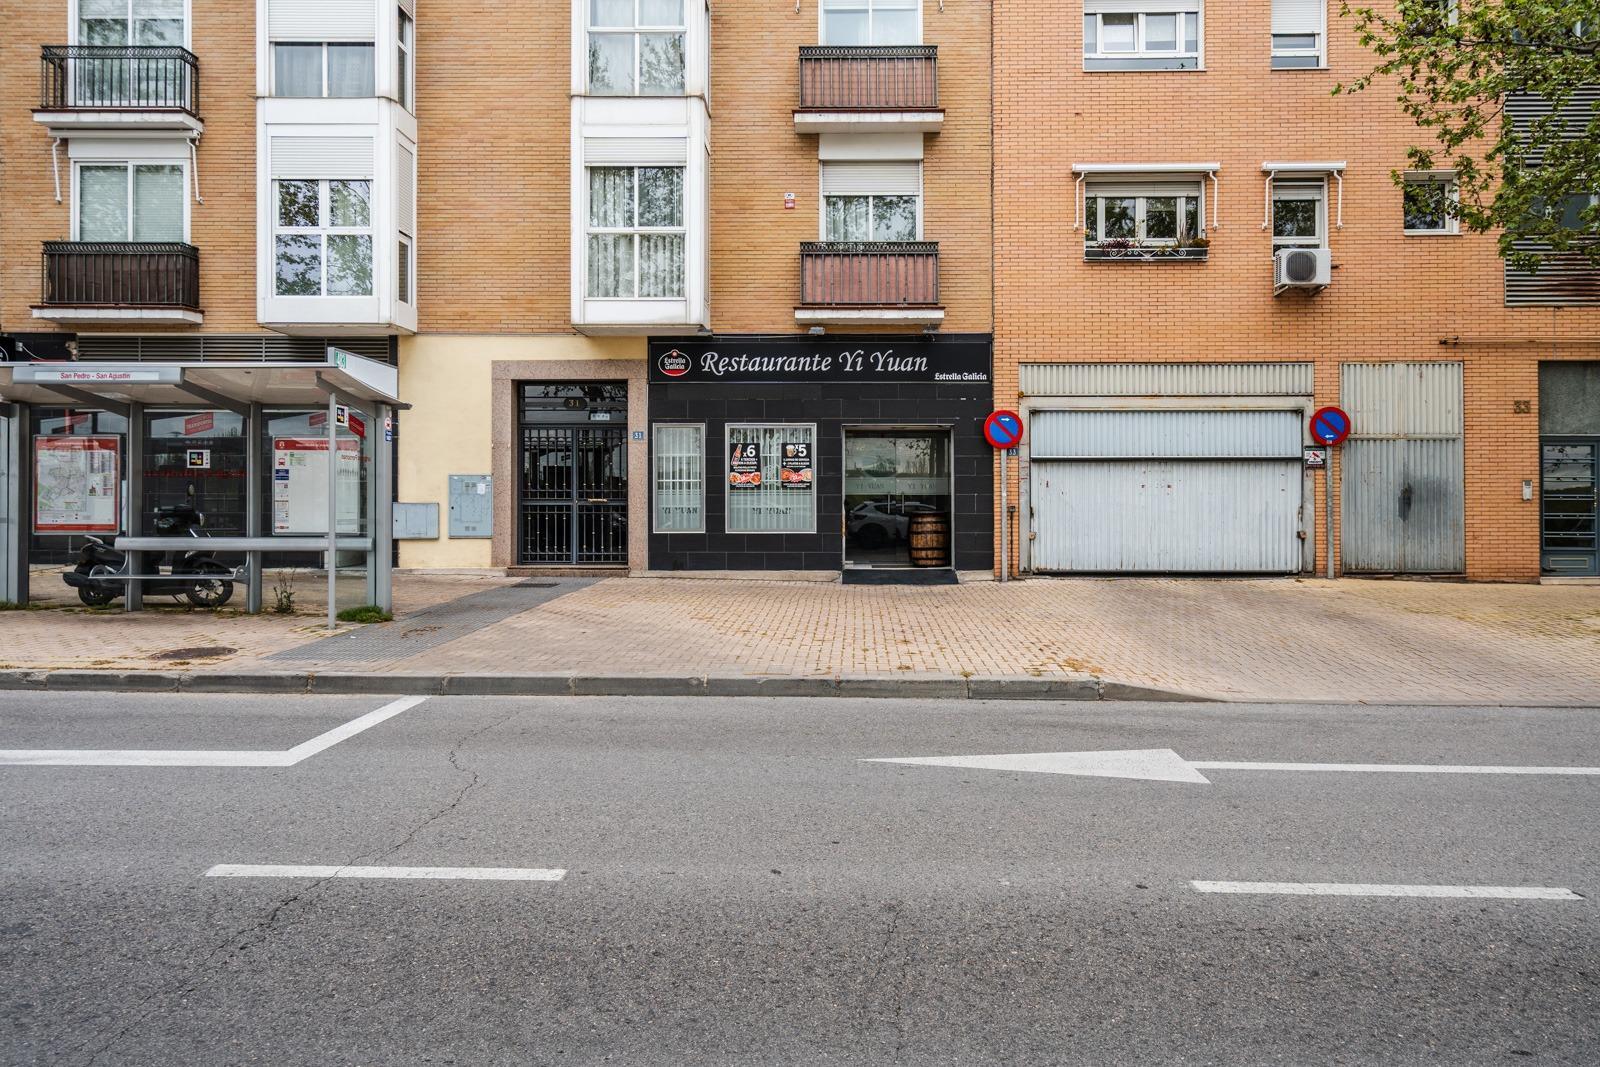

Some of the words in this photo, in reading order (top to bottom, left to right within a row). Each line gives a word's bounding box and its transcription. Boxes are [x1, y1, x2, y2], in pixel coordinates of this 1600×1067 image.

[664, 356, 686, 364] Estrella
[700, 351, 832, 376] Restaurante
[838, 349, 864, 372] Yi
[869, 349, 928, 372] Yuan
[934, 372, 962, 381] Estrella
[962, 372, 987, 381] Galicia
[568, 399, 579, 407] 31
[1514, 400, 1531, 414] 33
[634, 431, 642, 439] 31
